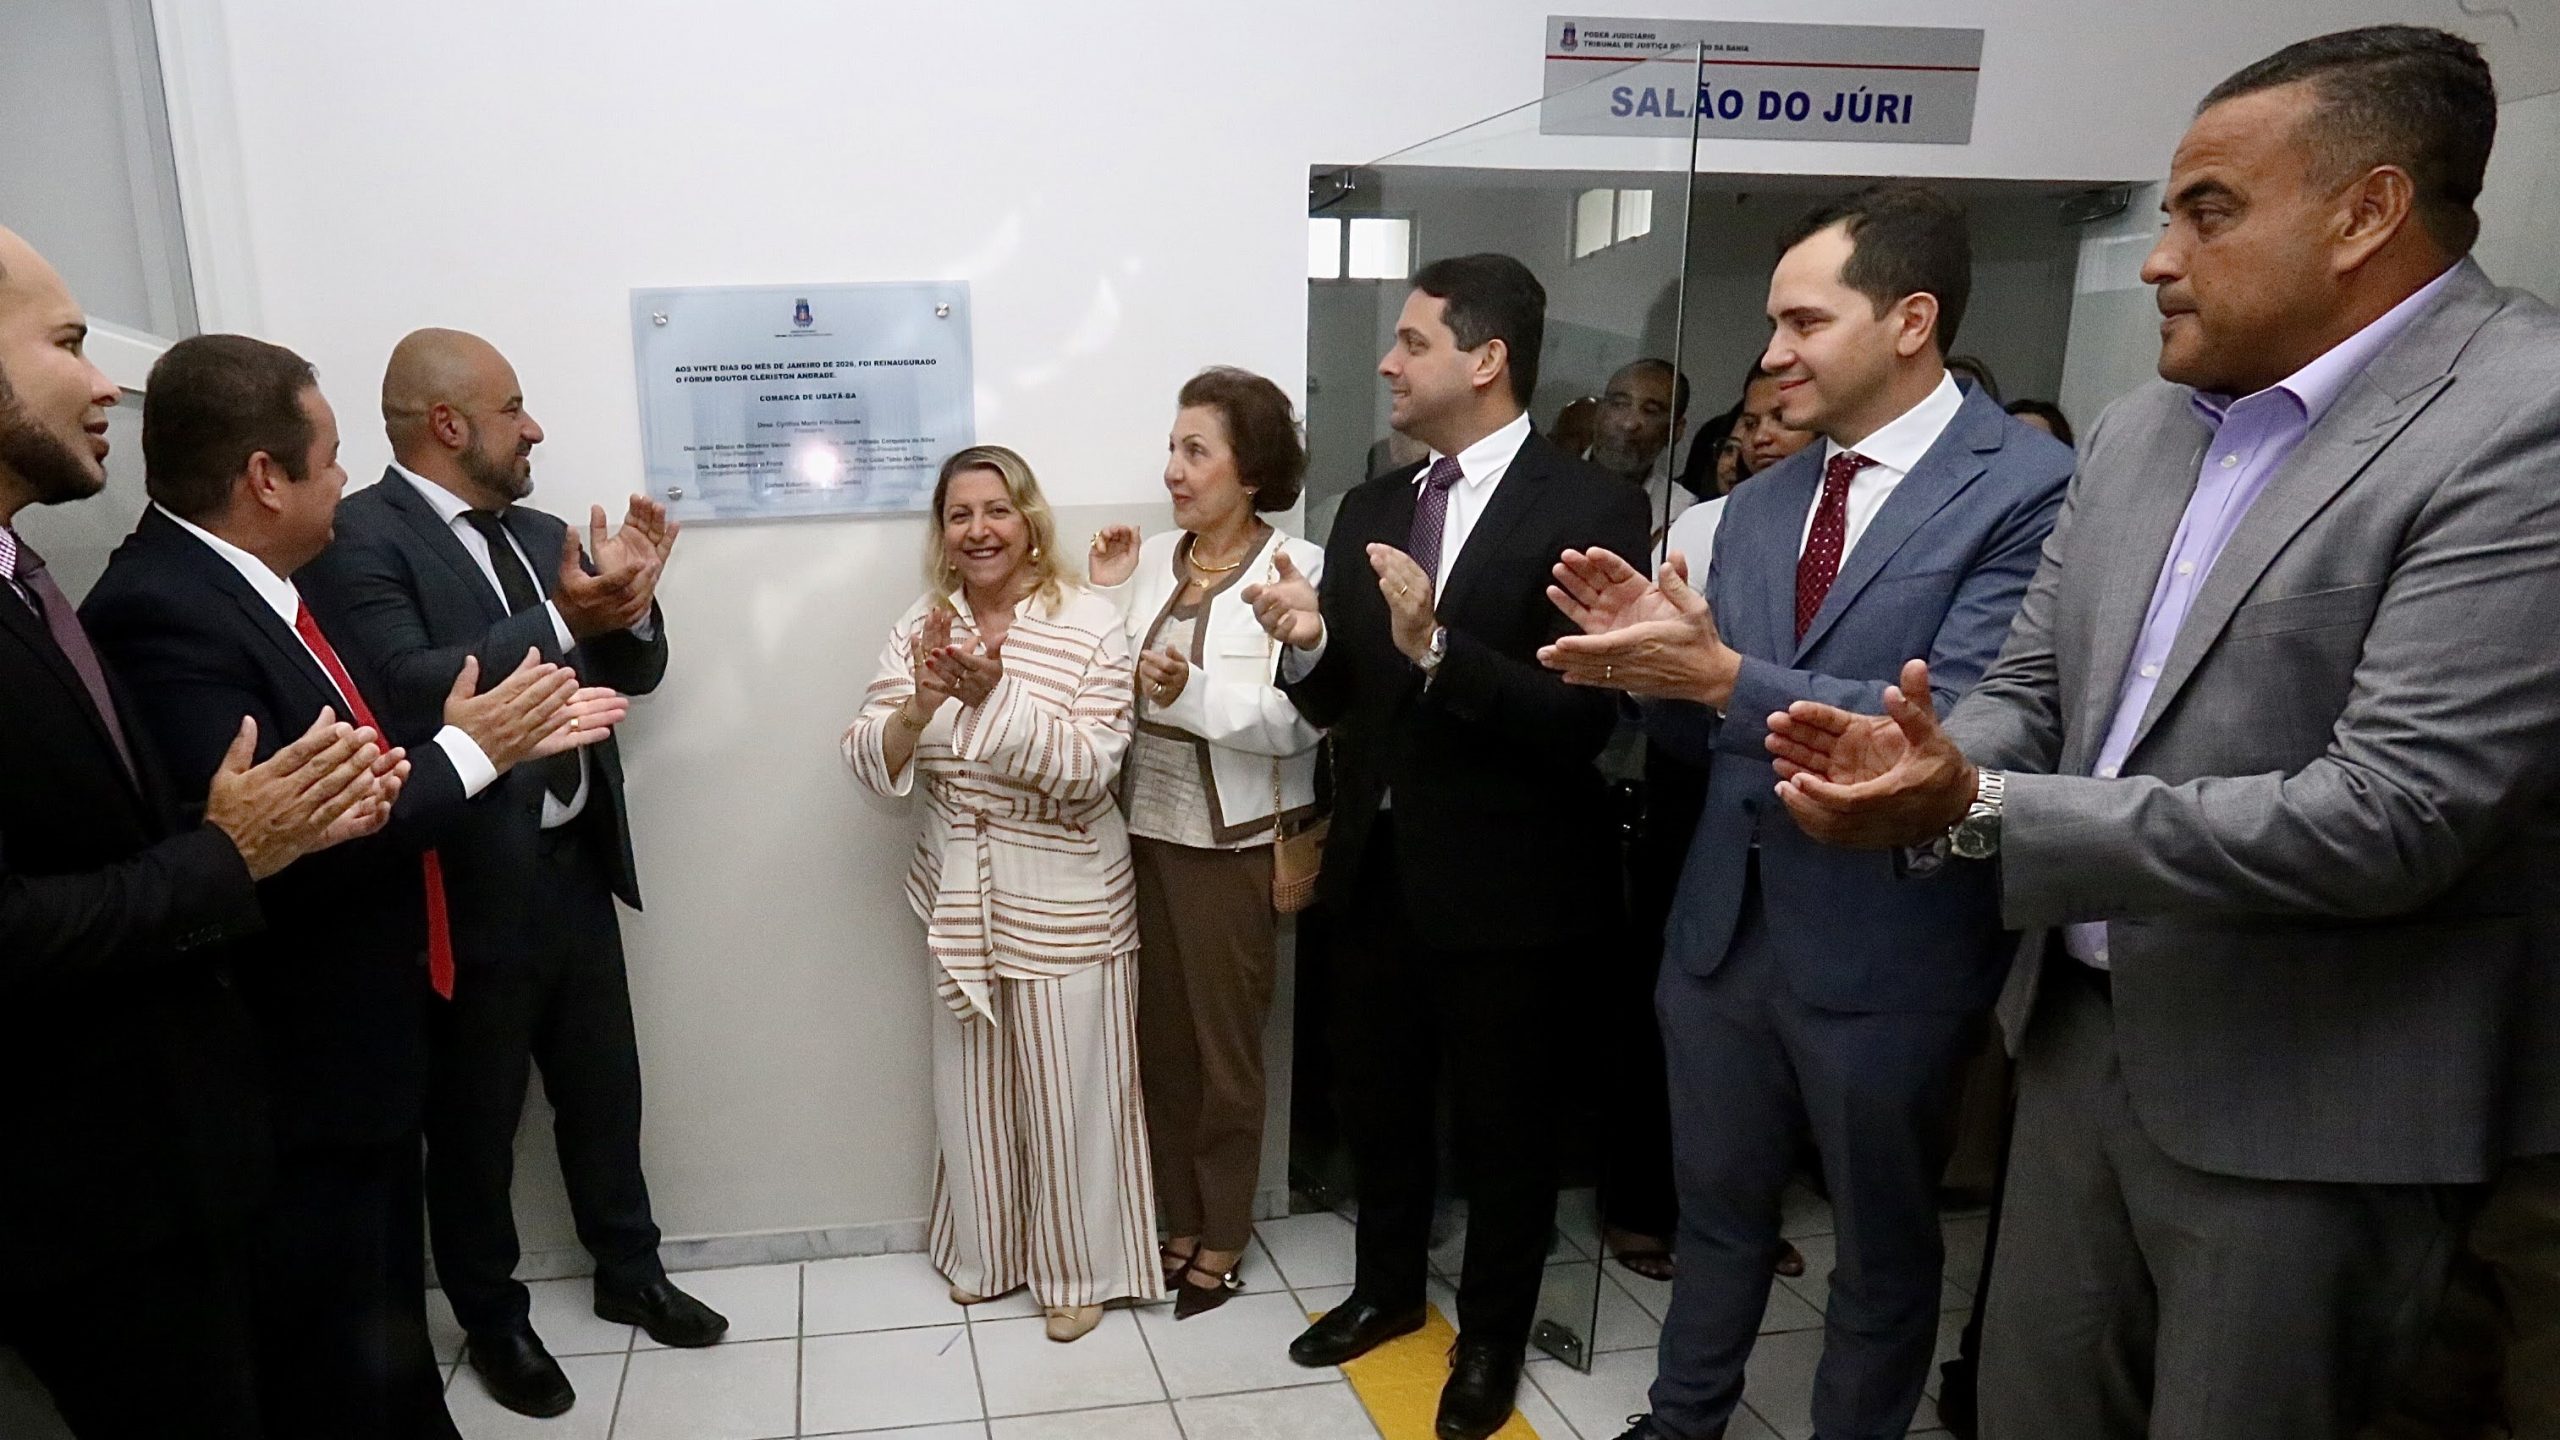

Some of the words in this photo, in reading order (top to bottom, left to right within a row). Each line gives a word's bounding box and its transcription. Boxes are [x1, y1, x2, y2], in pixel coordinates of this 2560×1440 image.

[1584, 31, 1609, 39] PODER
[1611, 31, 1656, 40] JUDICIÁRIO
[1583, 41, 1621, 49] TRIBUNAL
[1636, 42, 1668, 50] JUSTIÇA
[1610, 81, 1744, 121] SALÃO
[1758, 90, 1811, 122] DO
[1823, 86, 1914, 124] JÚRI
[759, 394, 800, 402] COMARCA
